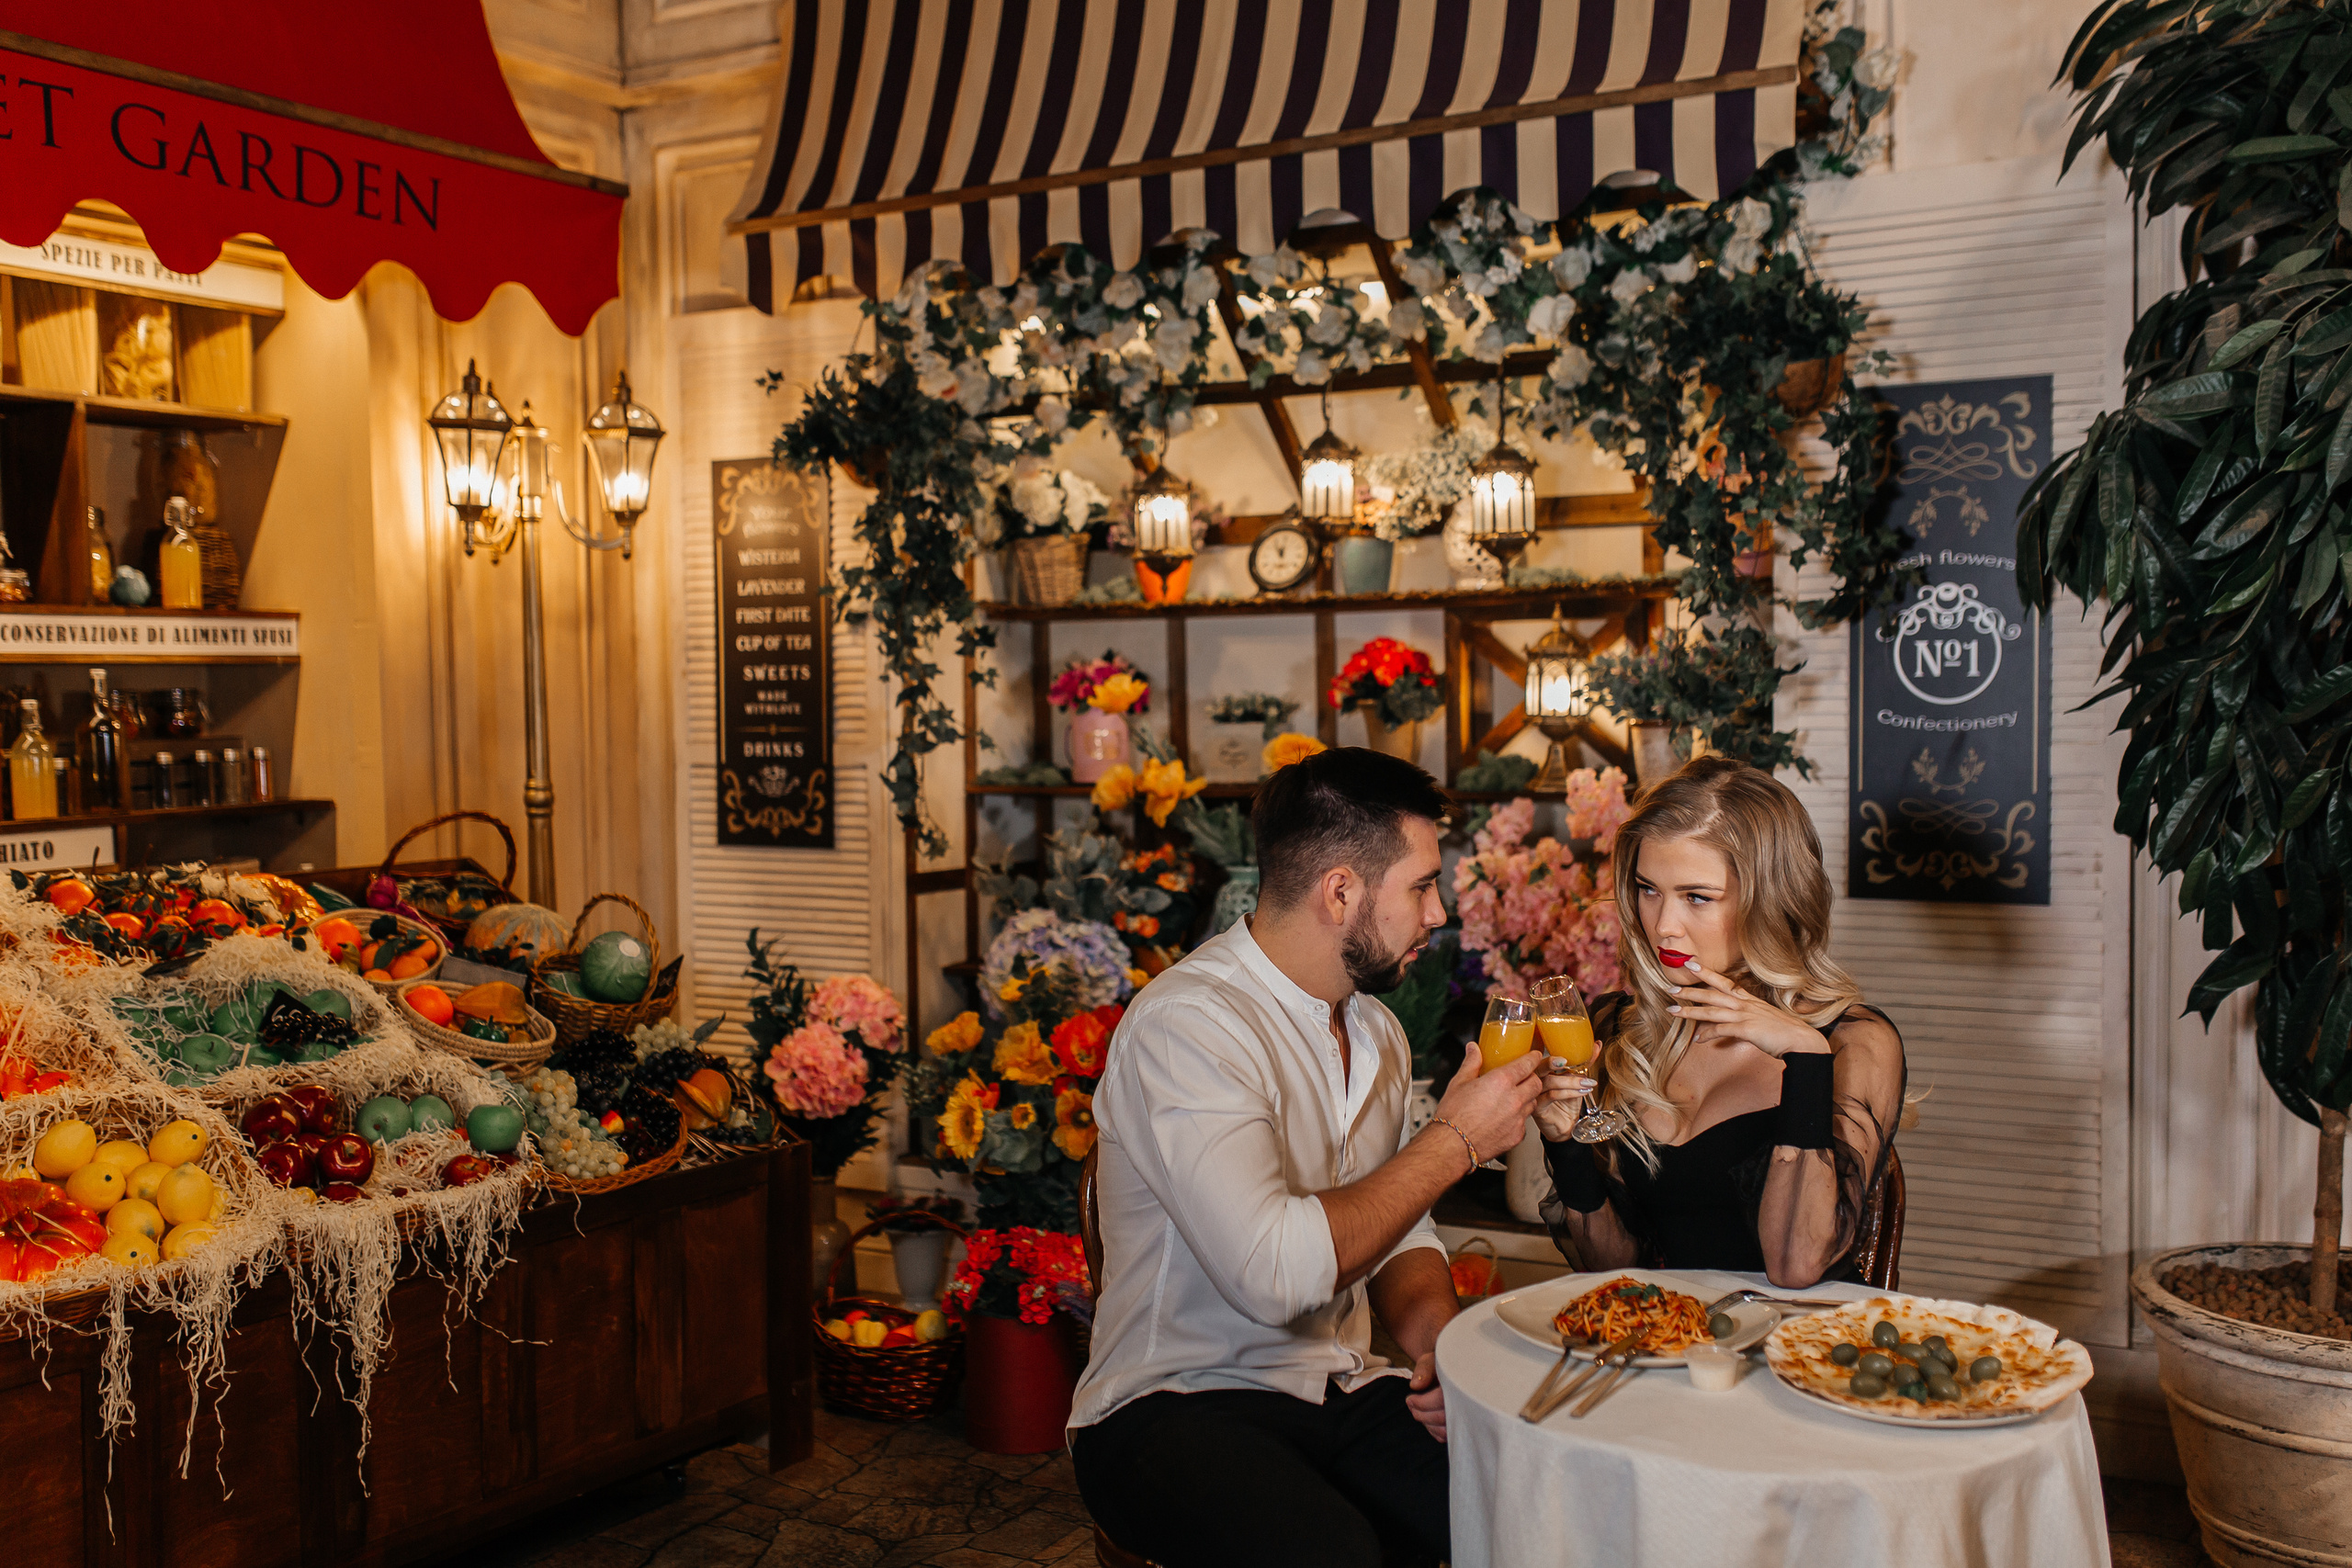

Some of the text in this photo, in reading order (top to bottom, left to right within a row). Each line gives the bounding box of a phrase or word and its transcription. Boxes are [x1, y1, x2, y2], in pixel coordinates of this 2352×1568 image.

[110, 102, 441, 231] GARDEN
[40, 242, 101, 268] SPEZIE
[110, 254, 145, 277] PER
[1883, 549, 2017, 572] esh flowers
[0, 623, 138, 643] CONSERVAZIONE
[148, 626, 164, 643] DI
[173, 626, 246, 645] ALIMENTI
[736, 634, 812, 651] CUP OF TEA
[742, 663, 811, 682] SWEETS
[1877, 709, 2018, 732] Confectionery
[742, 740, 805, 758] DRINKS
